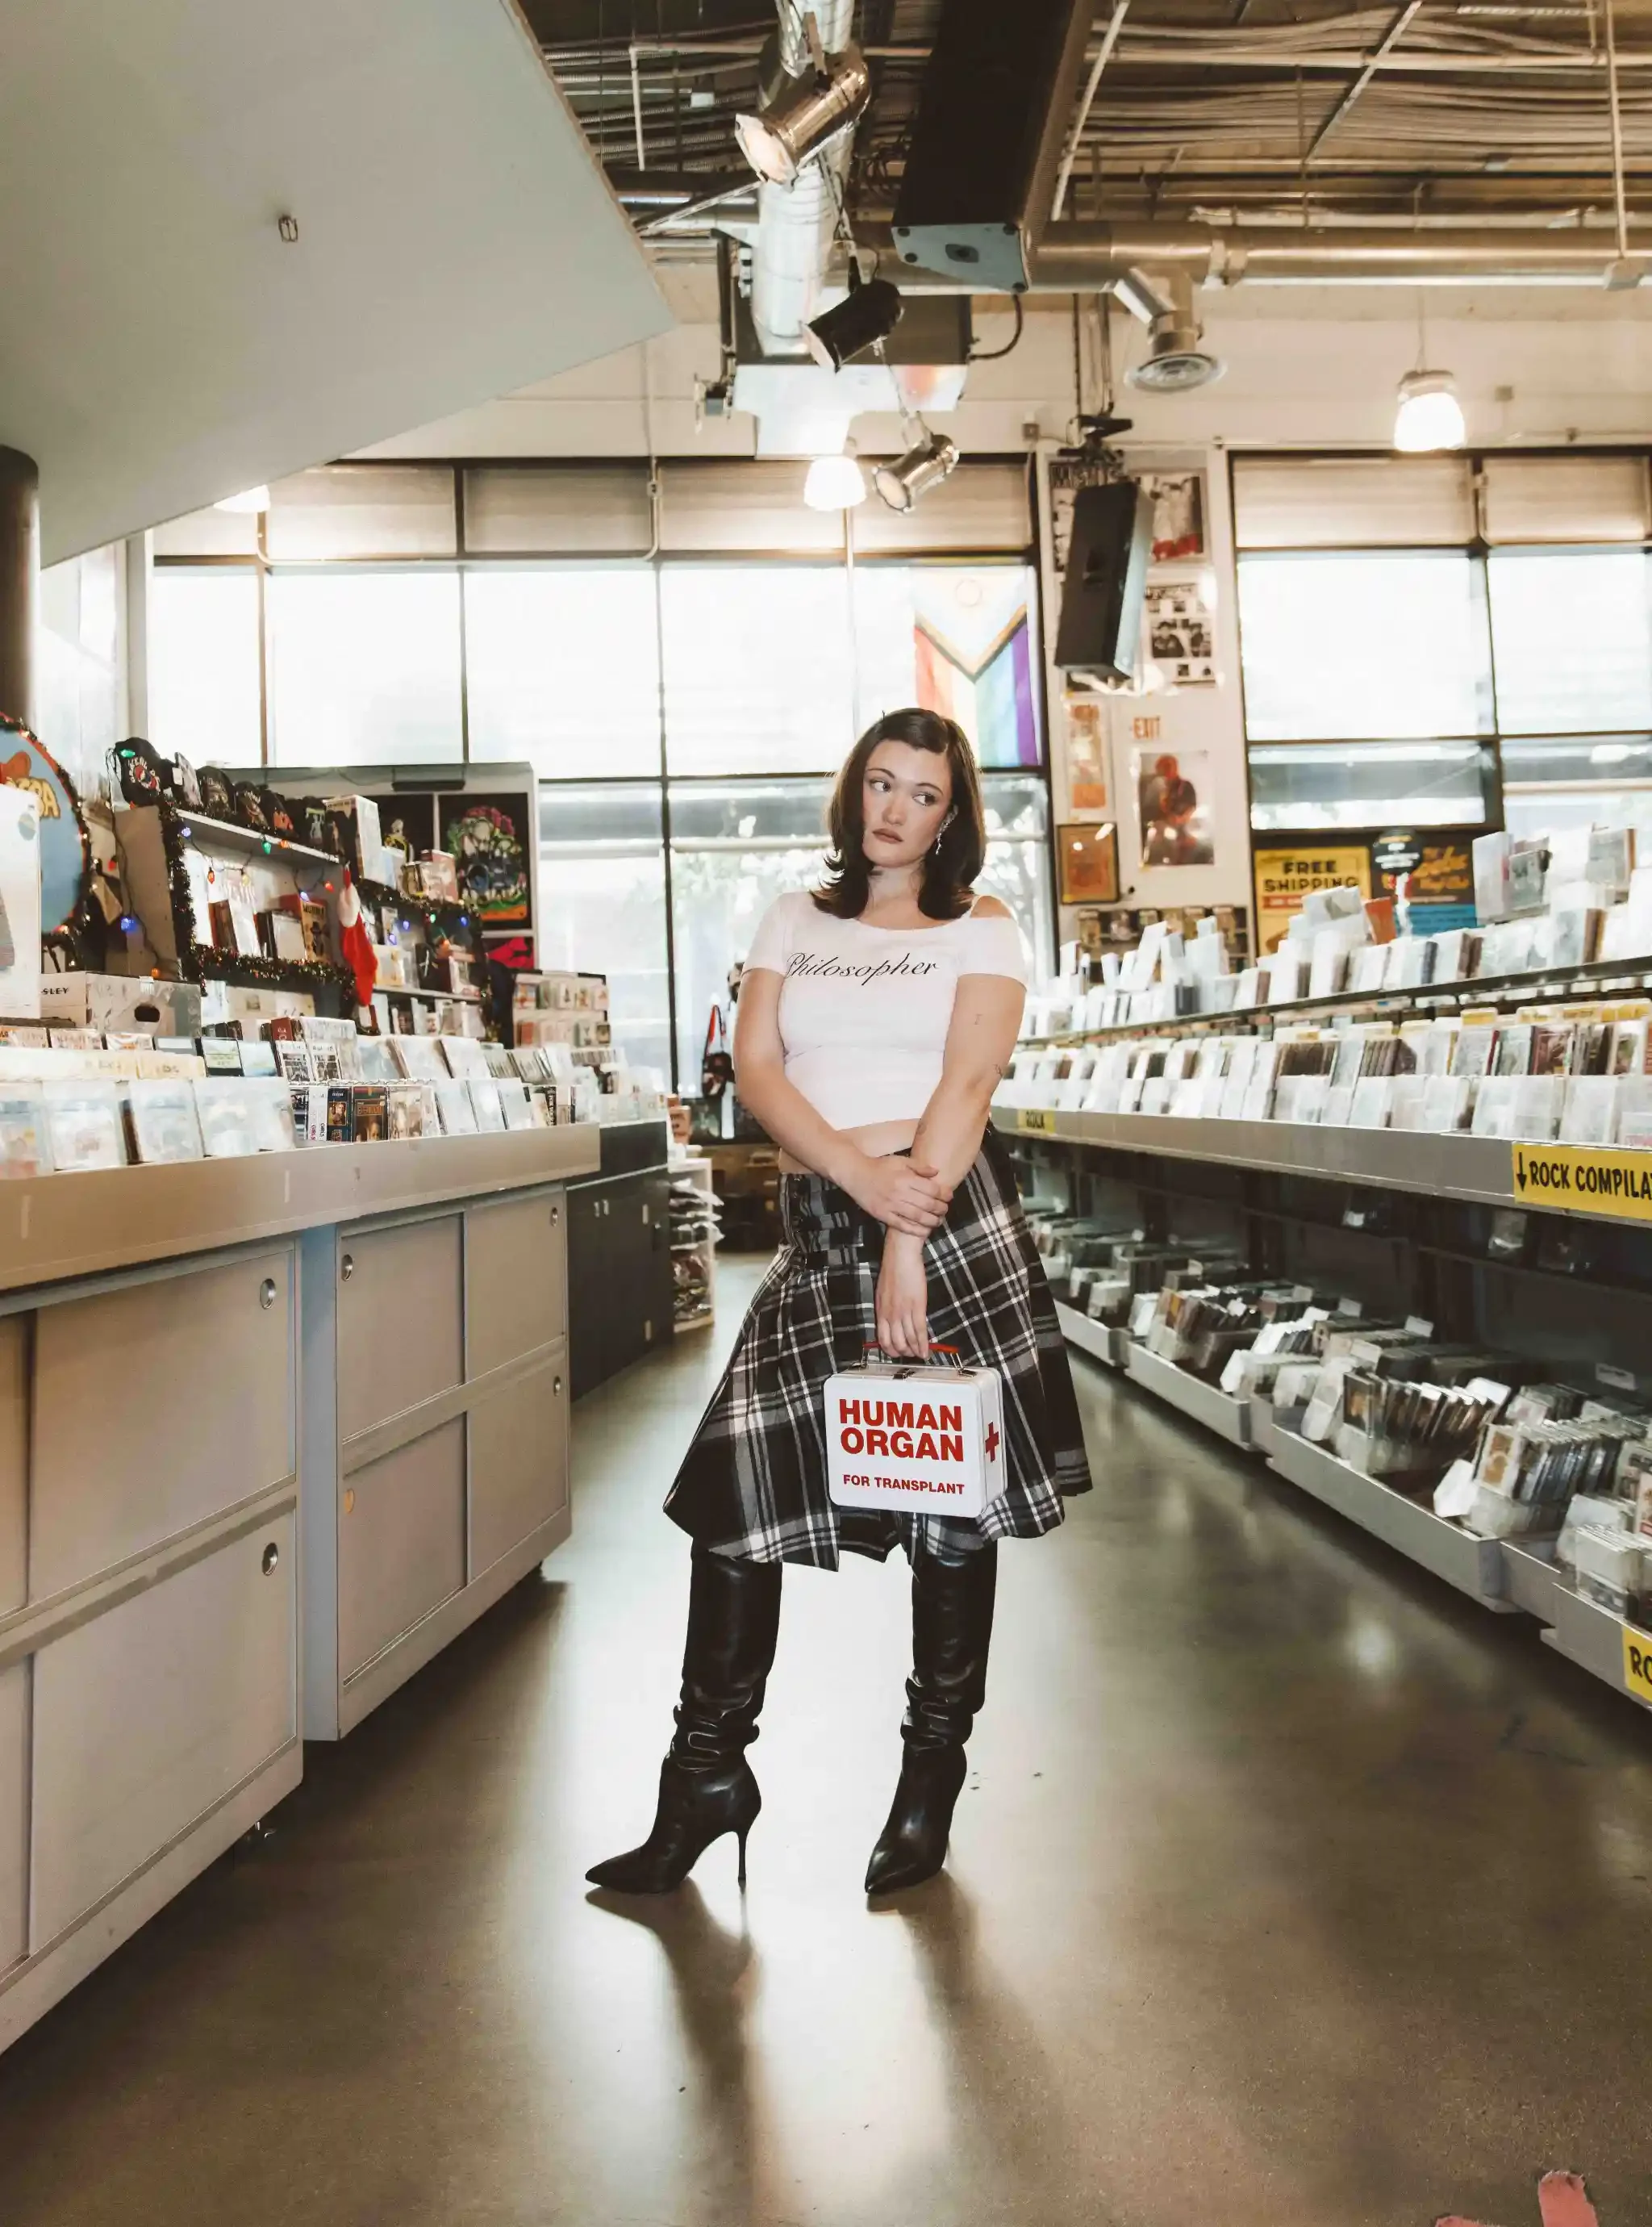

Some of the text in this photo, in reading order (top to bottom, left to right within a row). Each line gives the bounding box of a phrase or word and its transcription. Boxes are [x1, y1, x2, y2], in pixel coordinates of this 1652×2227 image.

[1283, 860, 1337, 874] FREE
[1264, 877, 1359, 892] SHIPPING
[785, 953, 940, 986] Philosopher
[1529, 1160, 1652, 1201] ROCK COMPILA
[839, 1398, 962, 1431] HUMAN
[841, 1427, 964, 1462] ORGAN
[843, 1474, 965, 1495] FOR TRANSPLANT
